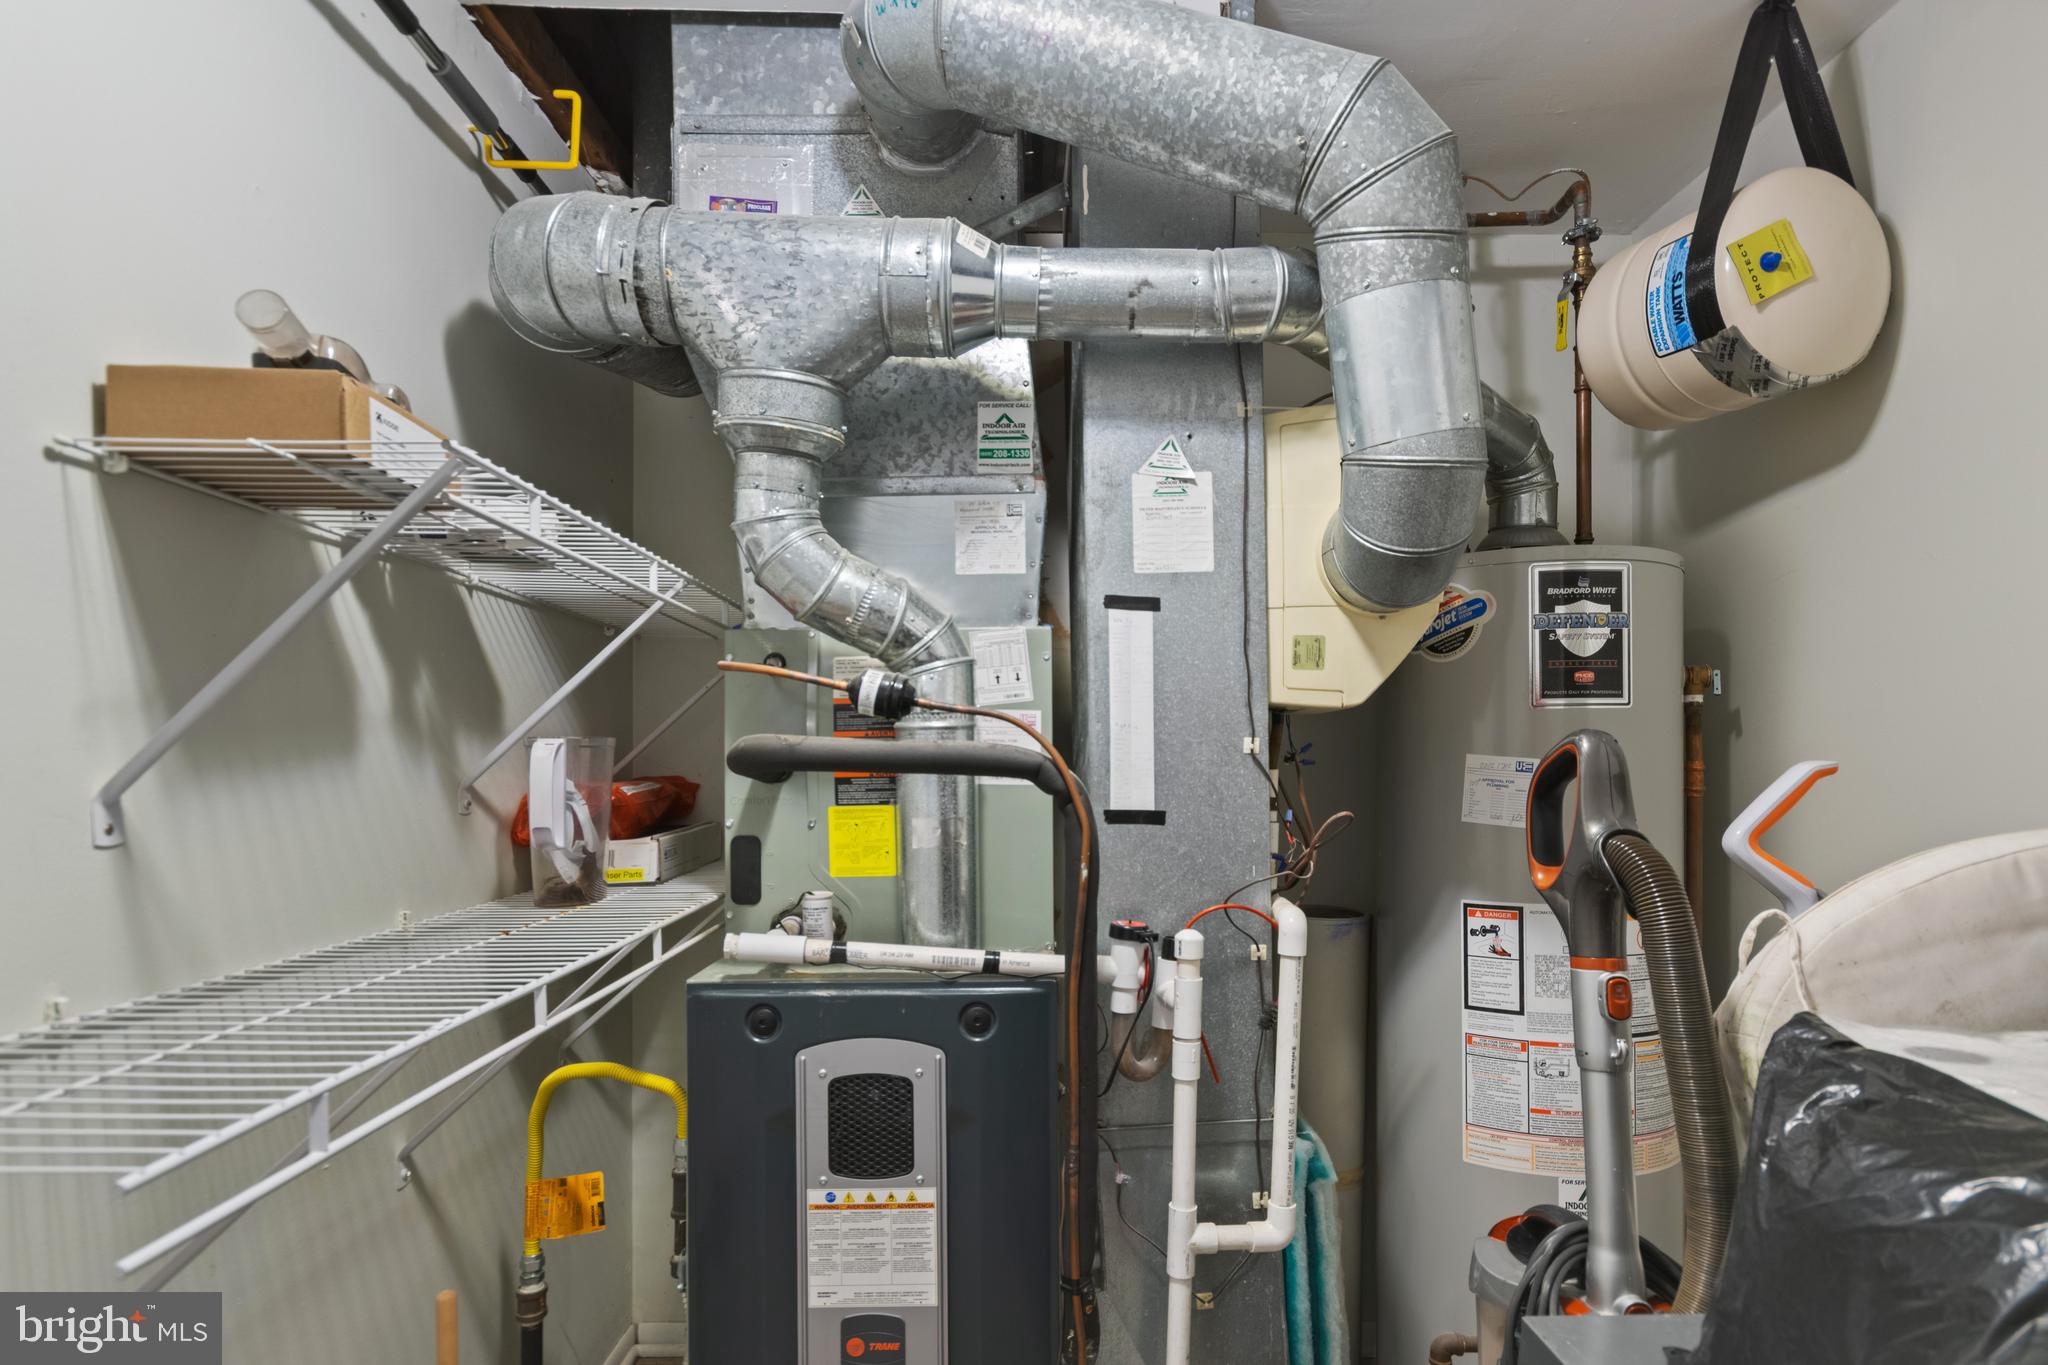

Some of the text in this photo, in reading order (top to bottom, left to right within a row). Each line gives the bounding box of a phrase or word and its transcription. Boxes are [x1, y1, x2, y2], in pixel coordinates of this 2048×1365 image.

[1737, 243, 1765, 300] PROTECT
[1672, 271, 1686, 325] WATTS
[1650, 318, 1662, 352] POTABLE
[1656, 310, 1670, 350] EXPANSION
[1547, 587, 1591, 595] BRADFORD
[1534, 613, 1629, 629] DEFENDER
[869, 1343, 901, 1351] TRANE
